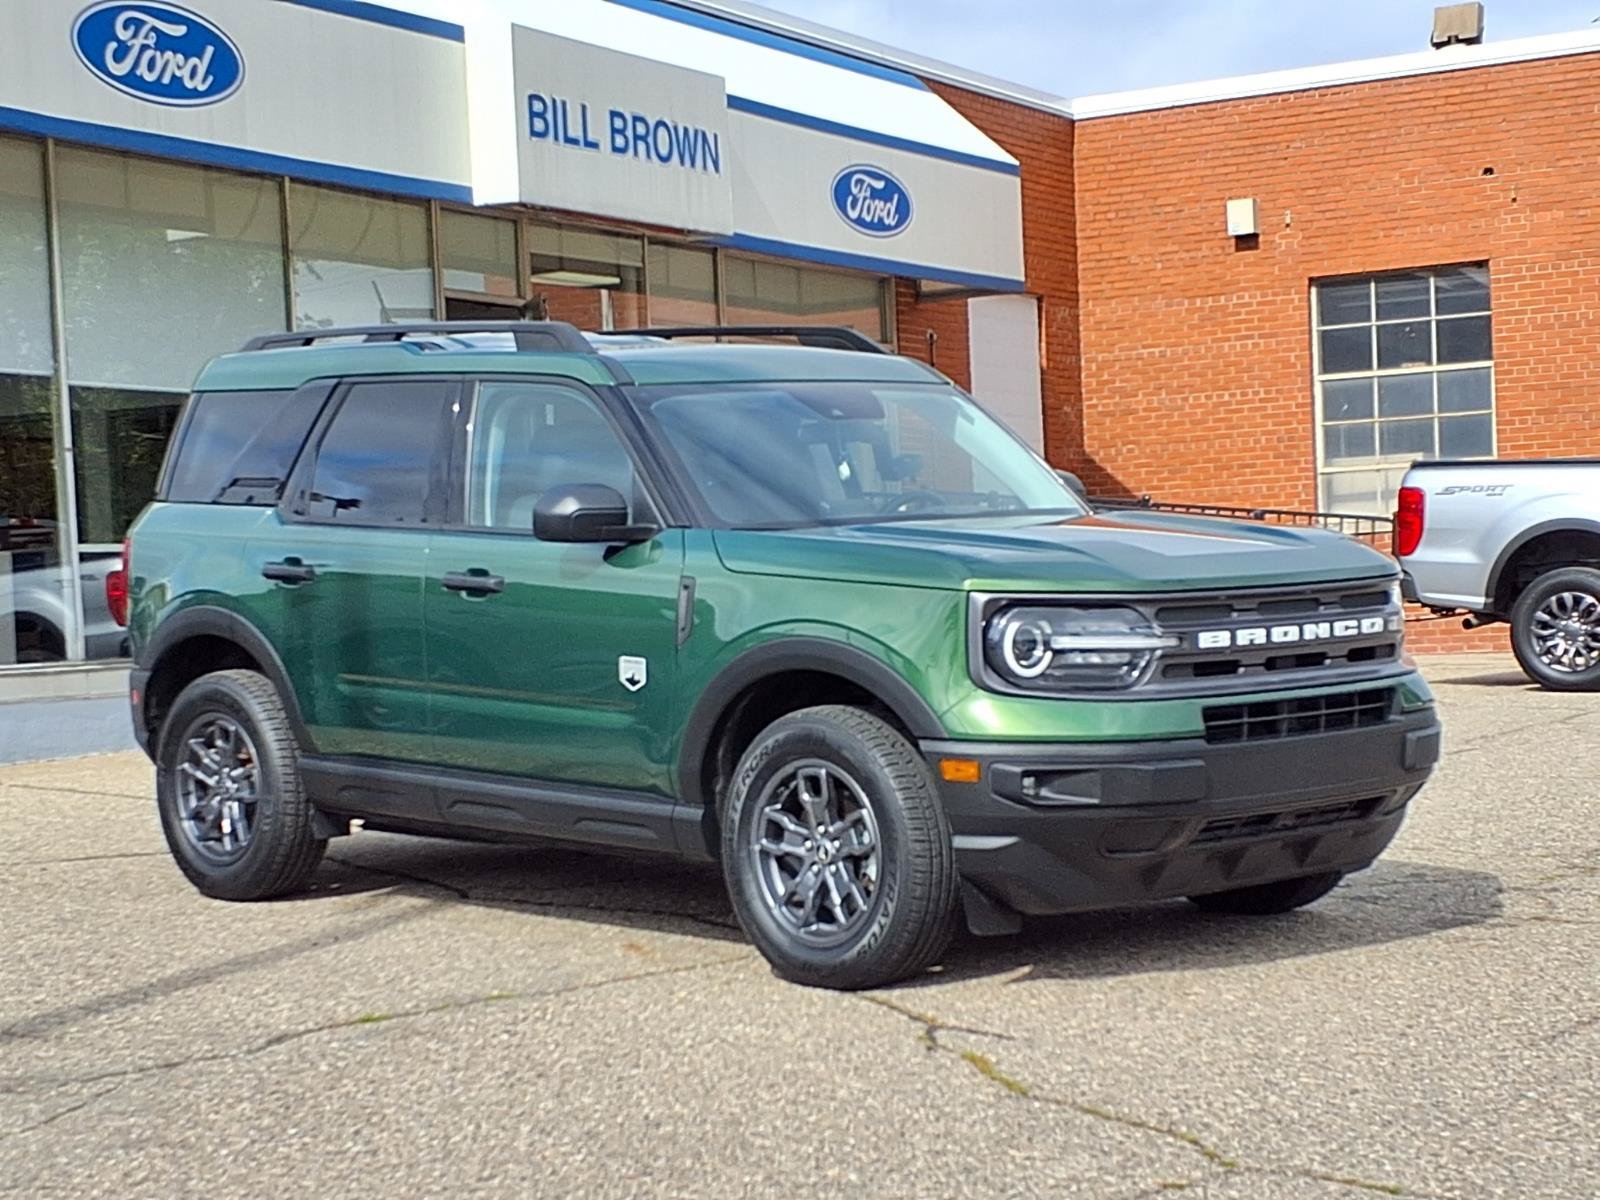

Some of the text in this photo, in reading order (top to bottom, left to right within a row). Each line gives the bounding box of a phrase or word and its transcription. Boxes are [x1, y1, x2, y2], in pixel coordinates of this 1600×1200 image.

[104, 10, 215, 92] Ford
[527, 93, 720, 174] BILL BROWN
[846, 173, 899, 227] Ford
[1434, 484, 1515, 496] SPORT
[1198, 616, 1385, 649] BRONCO
